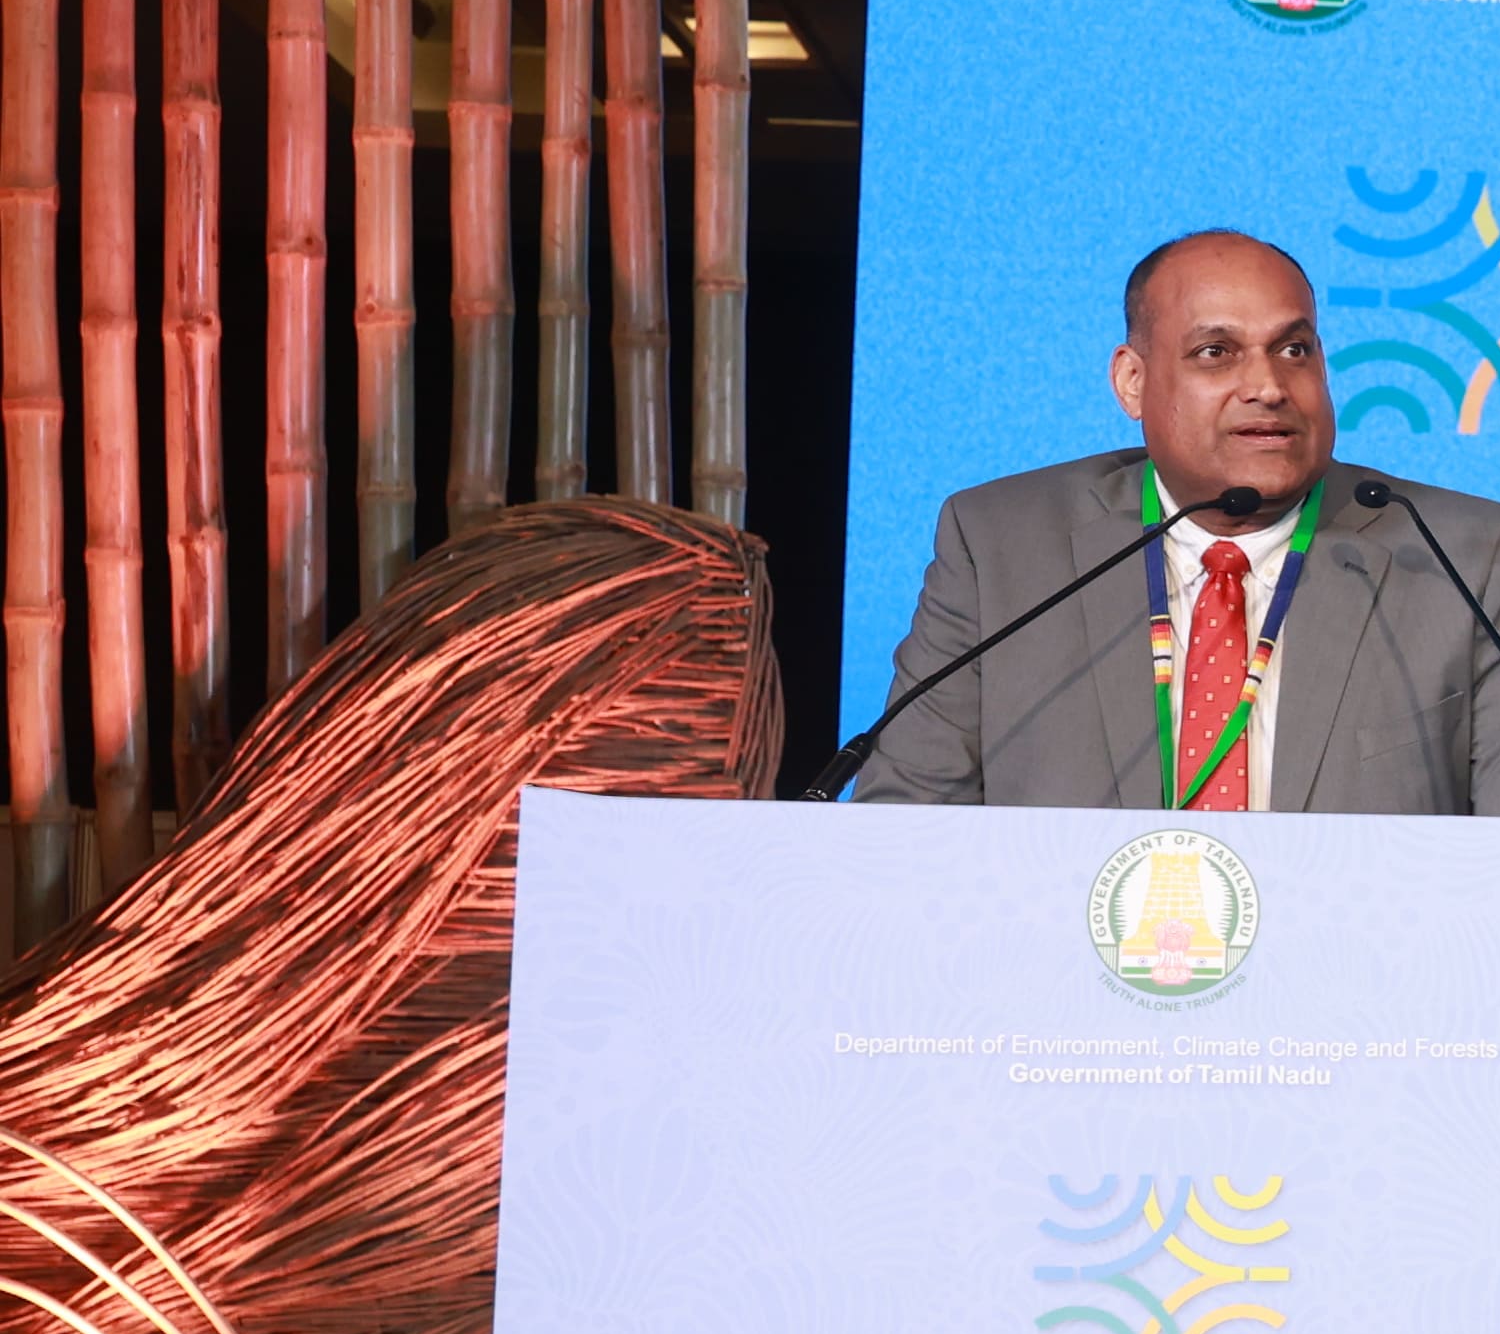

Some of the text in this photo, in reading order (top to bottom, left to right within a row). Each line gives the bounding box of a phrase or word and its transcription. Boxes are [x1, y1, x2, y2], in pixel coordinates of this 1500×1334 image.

[1092, 834, 1254, 938] GOVERNMENT OF TAMILNADU
[1097, 971, 1248, 1012] TRUTH ALONE TRIUMPHS
[834, 1033, 1499, 1064] Department of Environment, Climate Change and Forests
[1008, 1063, 1332, 1086] Government of Tamil Nadu
